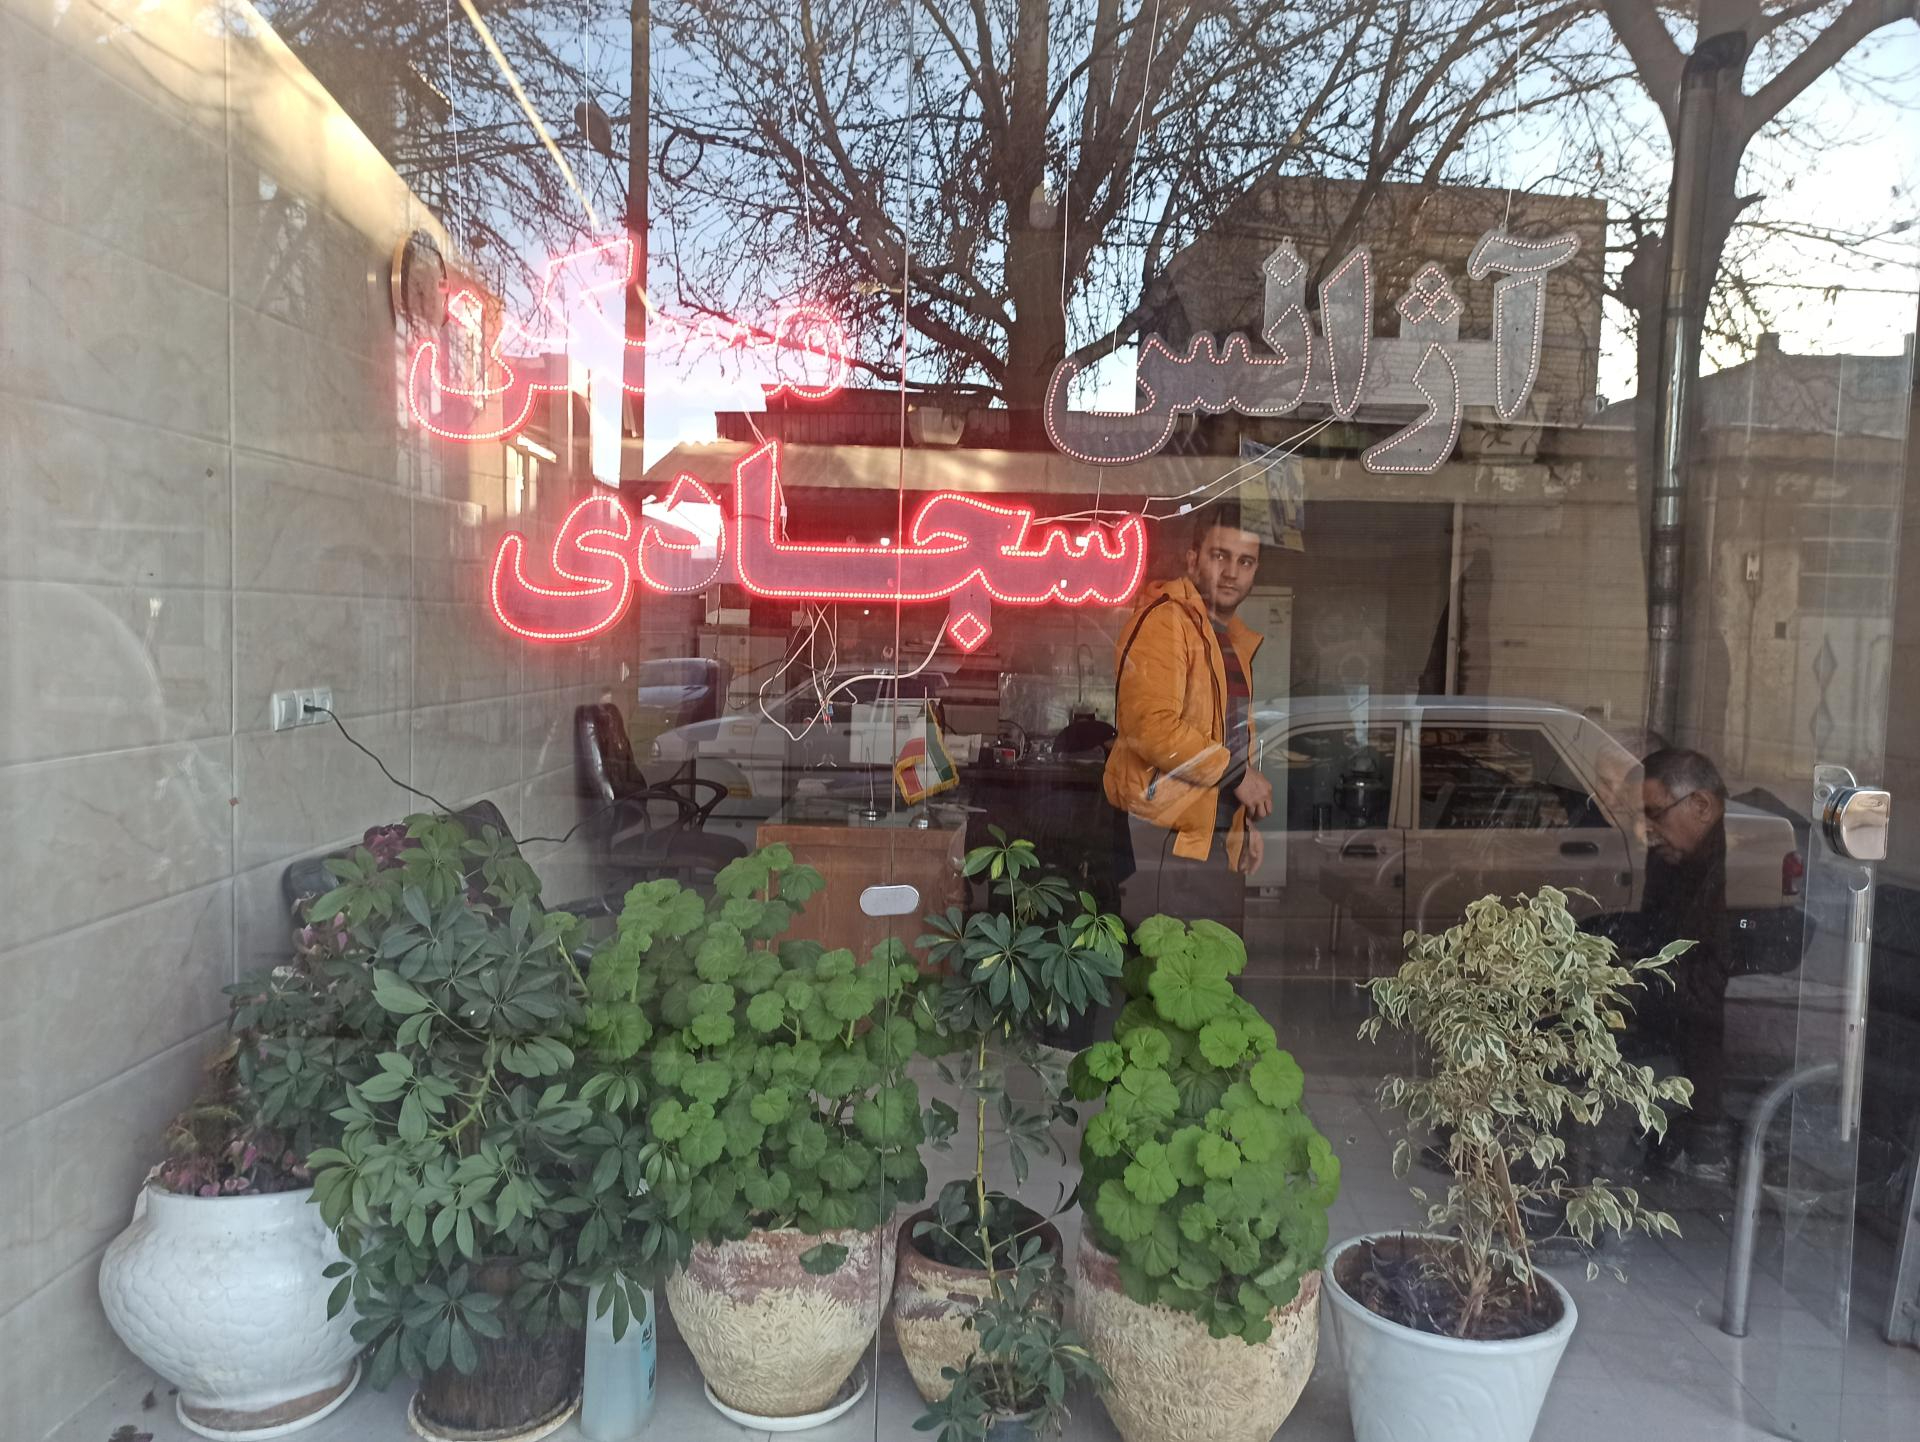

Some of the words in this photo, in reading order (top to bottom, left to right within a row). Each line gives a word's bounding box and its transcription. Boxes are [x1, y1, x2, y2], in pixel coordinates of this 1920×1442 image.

[407, 236, 850, 441] مسکن
[1044, 229, 1582, 476] آژانس
[489, 438, 1149, 652] سجادی
